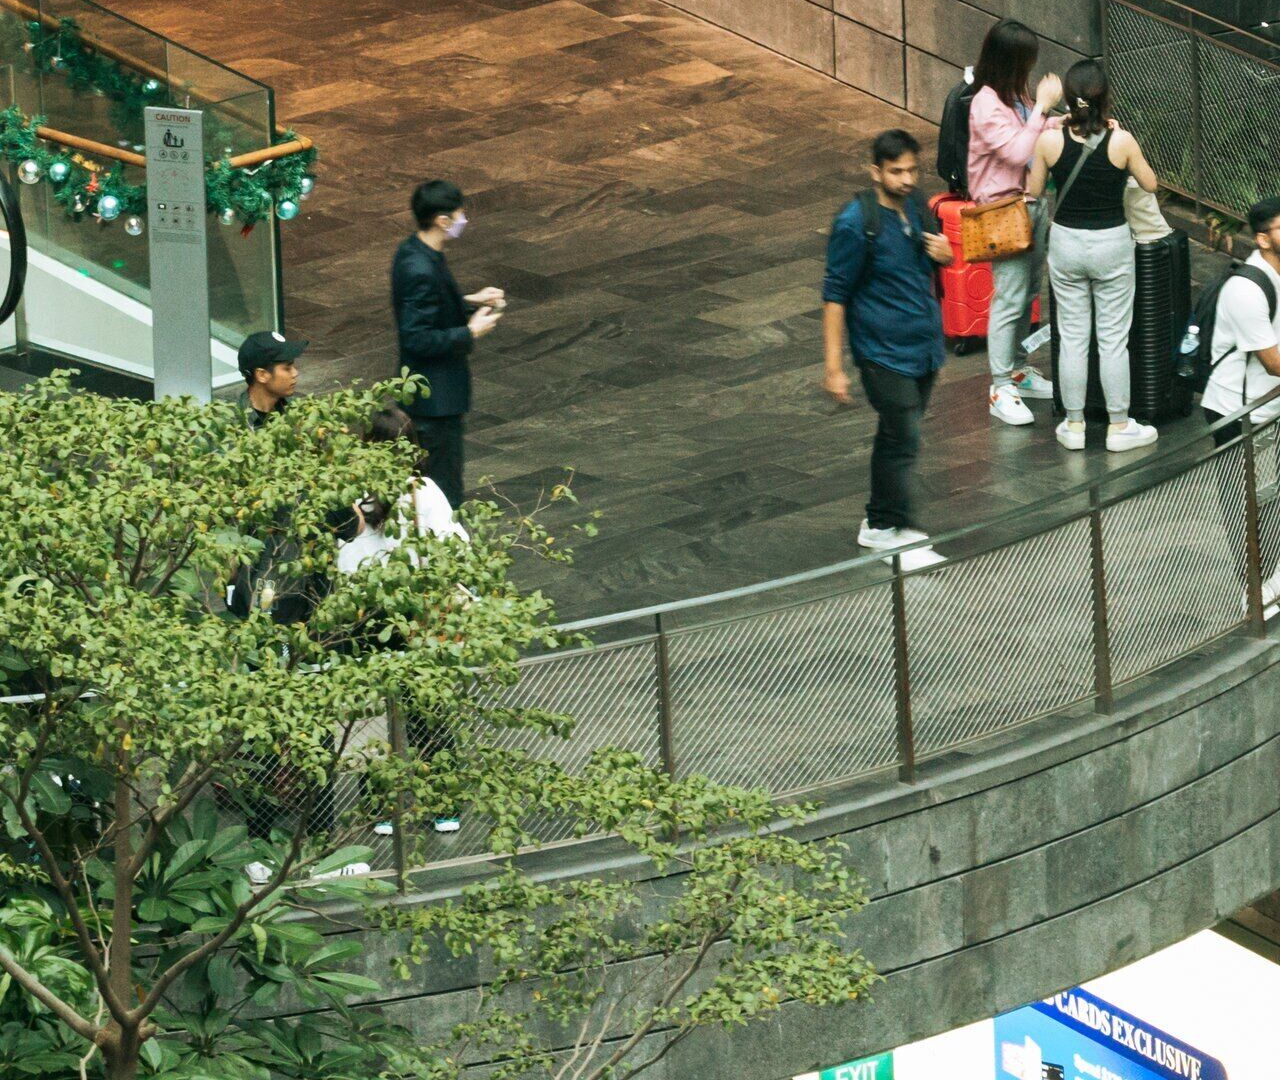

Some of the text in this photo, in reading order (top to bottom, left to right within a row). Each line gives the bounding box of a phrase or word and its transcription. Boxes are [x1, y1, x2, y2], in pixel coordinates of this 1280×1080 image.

[155, 113, 191, 123] CAUTION
[1055, 991, 1202, 1080] CARDS EXCLUSIVE
